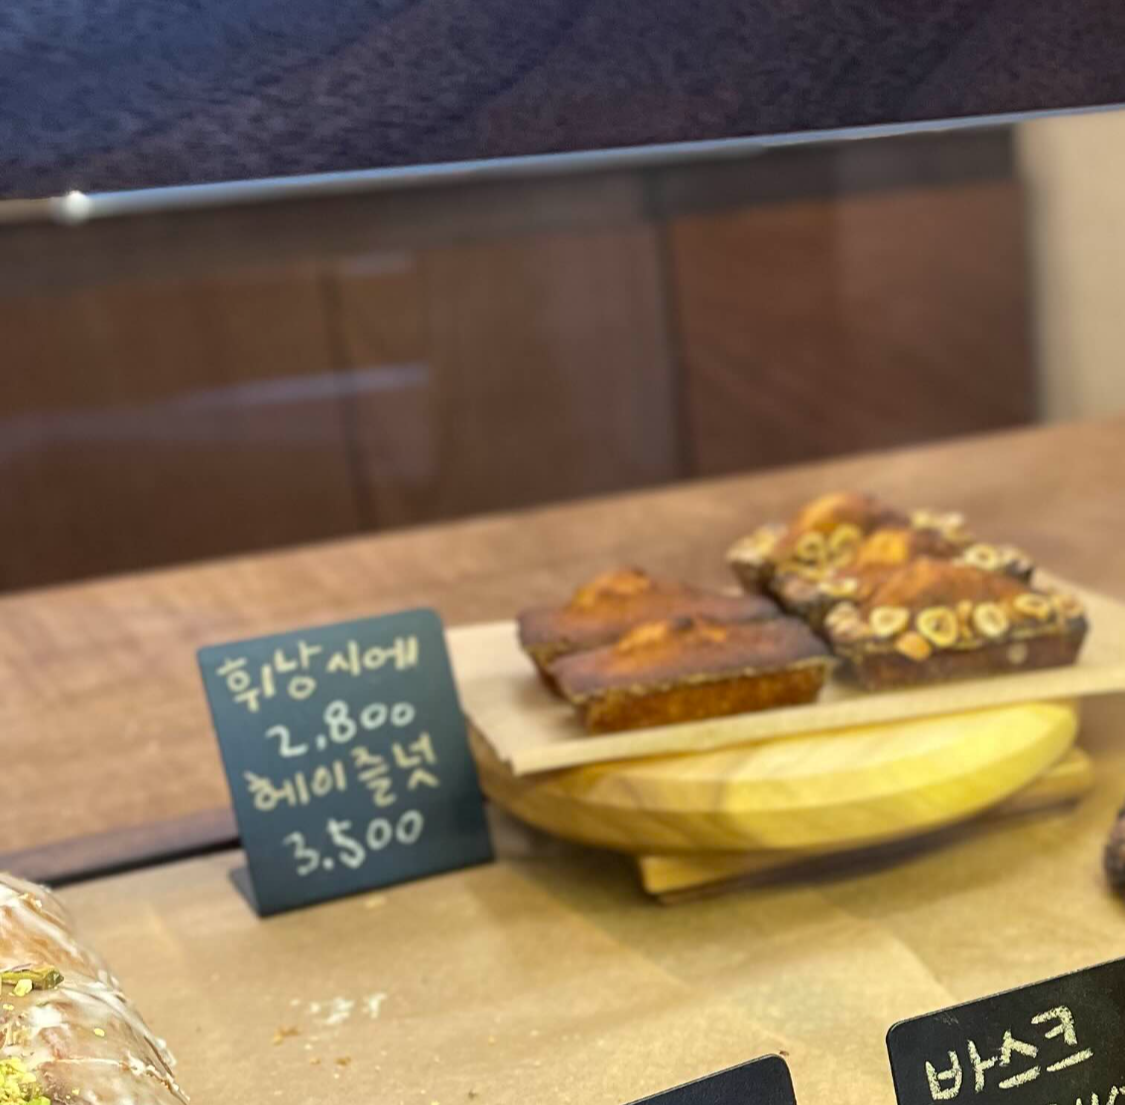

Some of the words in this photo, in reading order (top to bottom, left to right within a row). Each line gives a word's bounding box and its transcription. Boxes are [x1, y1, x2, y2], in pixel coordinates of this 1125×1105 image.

[217, 635, 419, 713] 휘낭시에
[265, 700, 415, 758] 2.800
[244, 732, 440, 808] 헤이즐넛
[283, 810, 424, 876] 3.500
[925, 1004, 1094, 1101] 바스크
